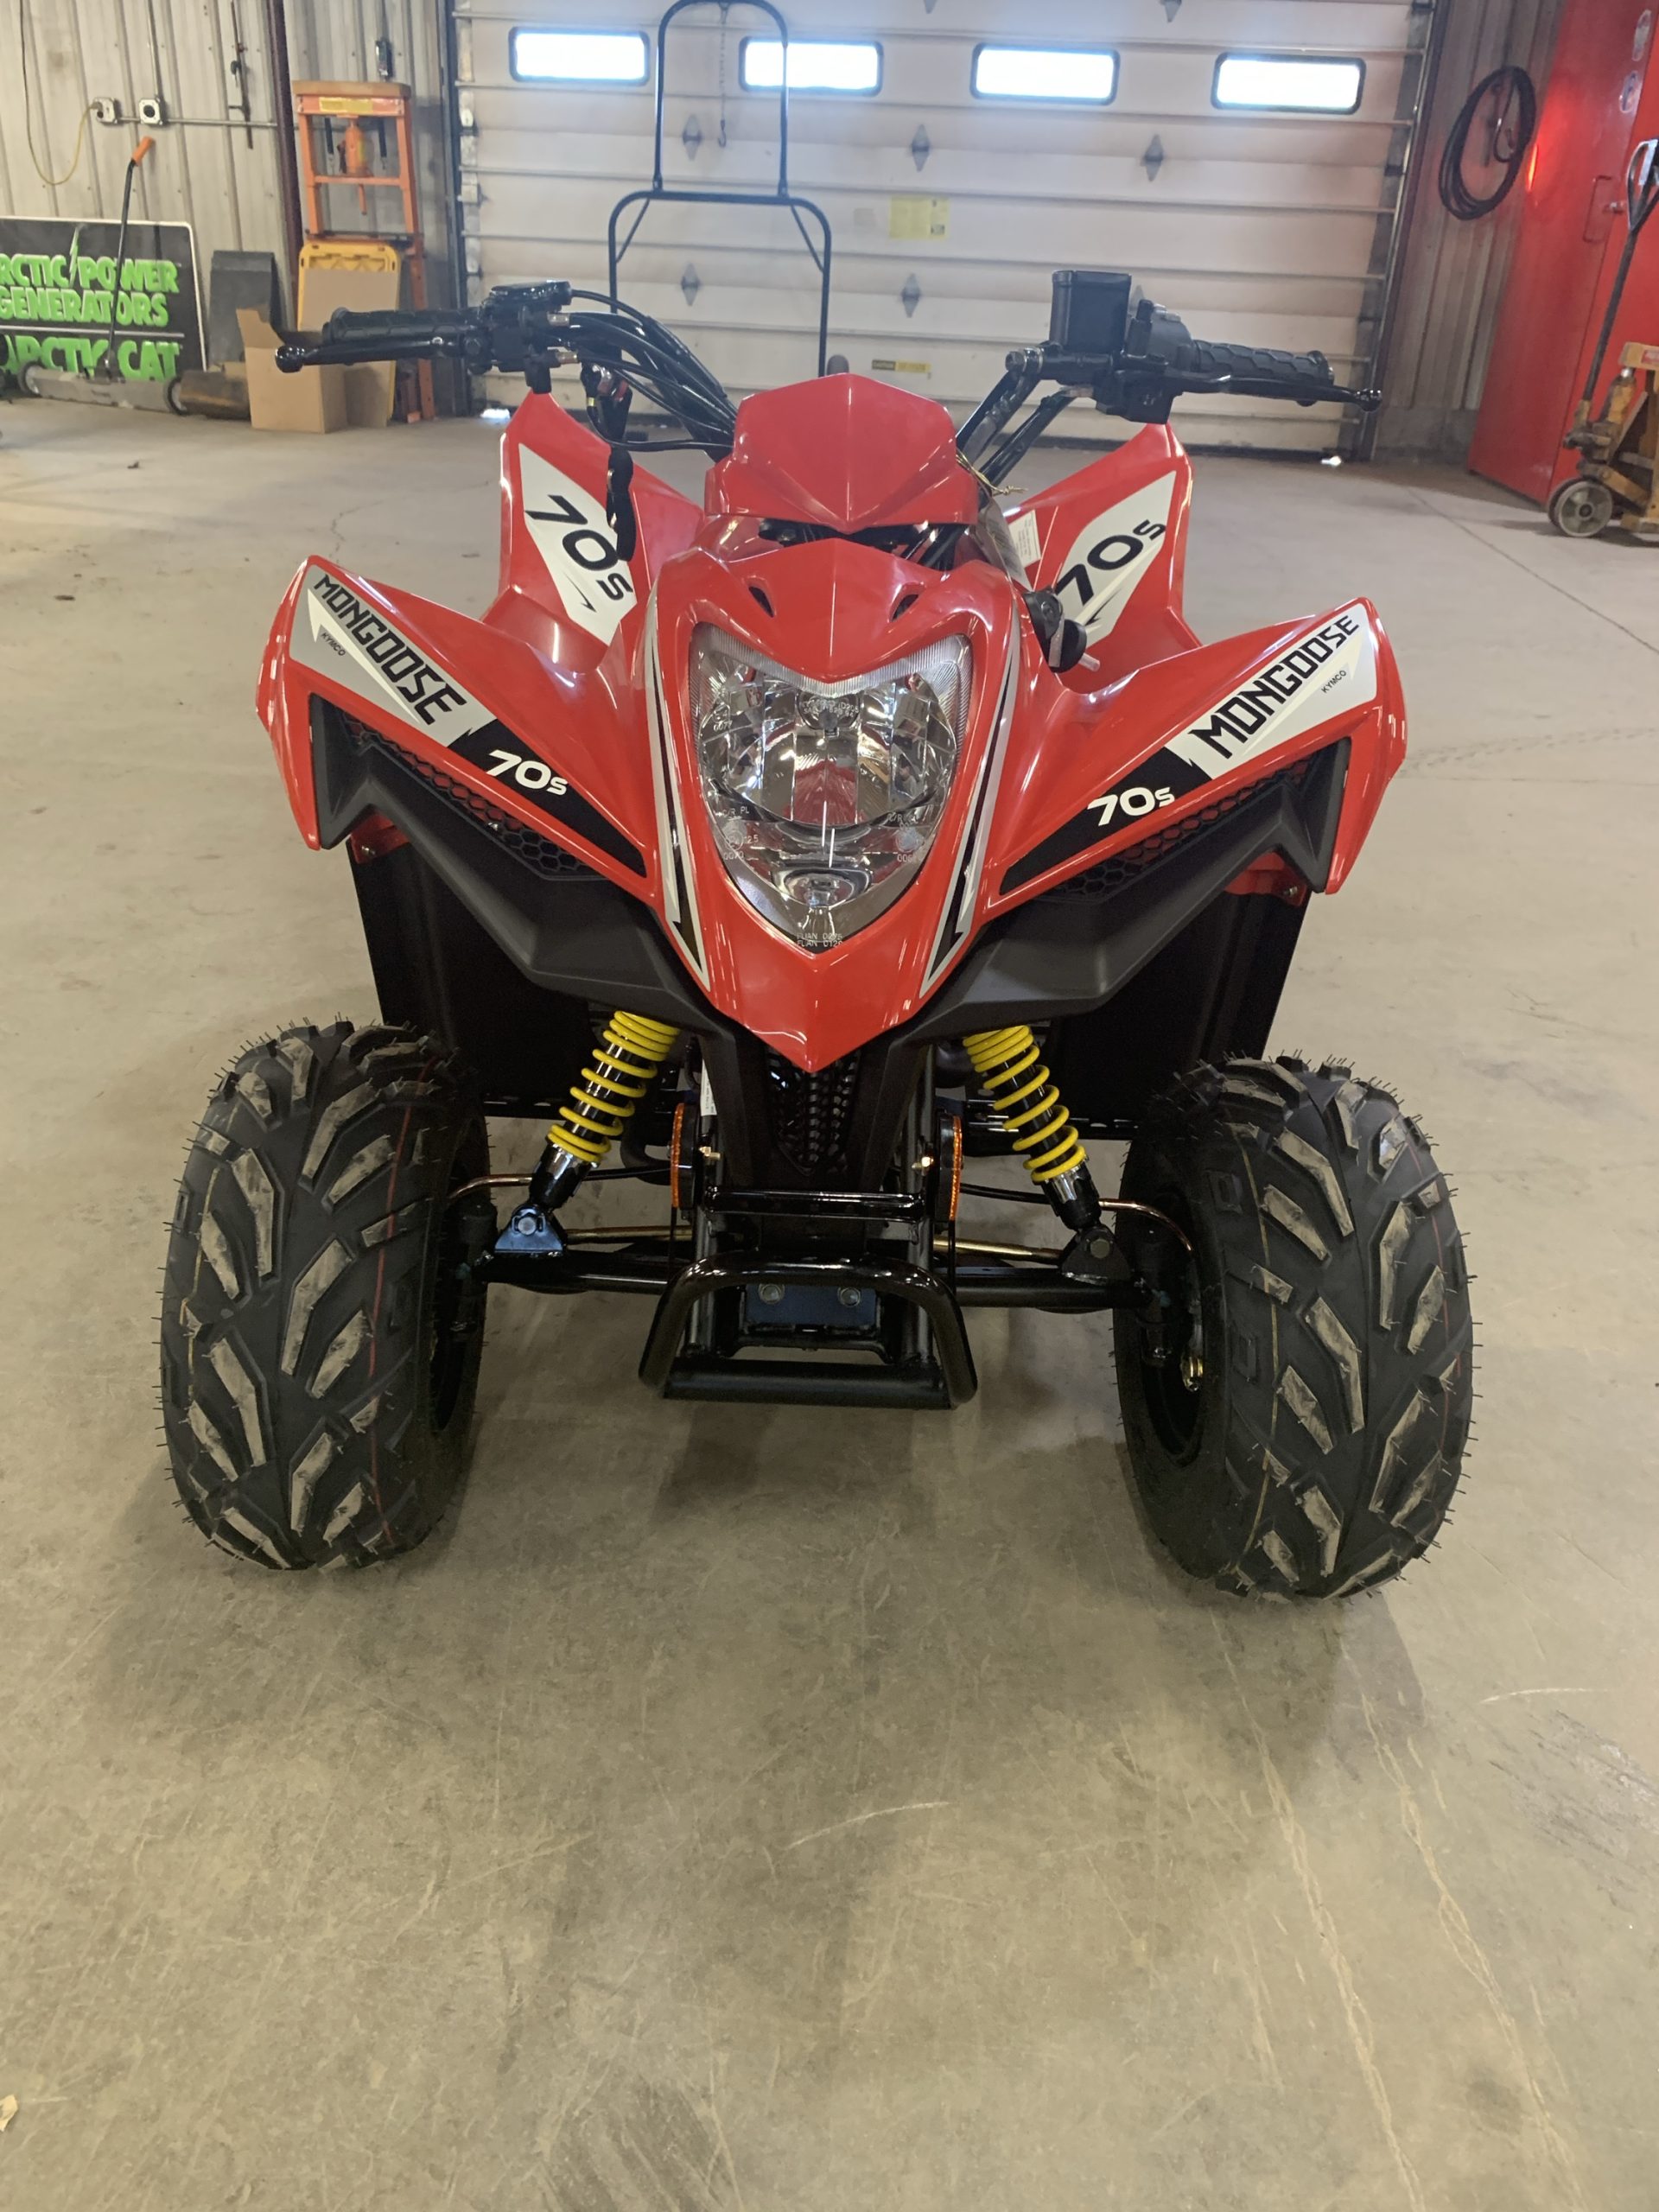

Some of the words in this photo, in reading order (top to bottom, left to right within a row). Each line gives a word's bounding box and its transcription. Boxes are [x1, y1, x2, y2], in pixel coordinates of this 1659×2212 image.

[0, 253, 69, 288] RCTIC
[77, 256, 180, 294] POWER
[0, 286, 169, 327] GENERATORS
[118, 340, 181, 381] CAT
[313, 574, 467, 725] MONGOOSE
[321, 632, 346, 657] KYMCO
[1188, 615, 1361, 760] MONGOOSE
[1321, 670, 1347, 694] KYMCO
